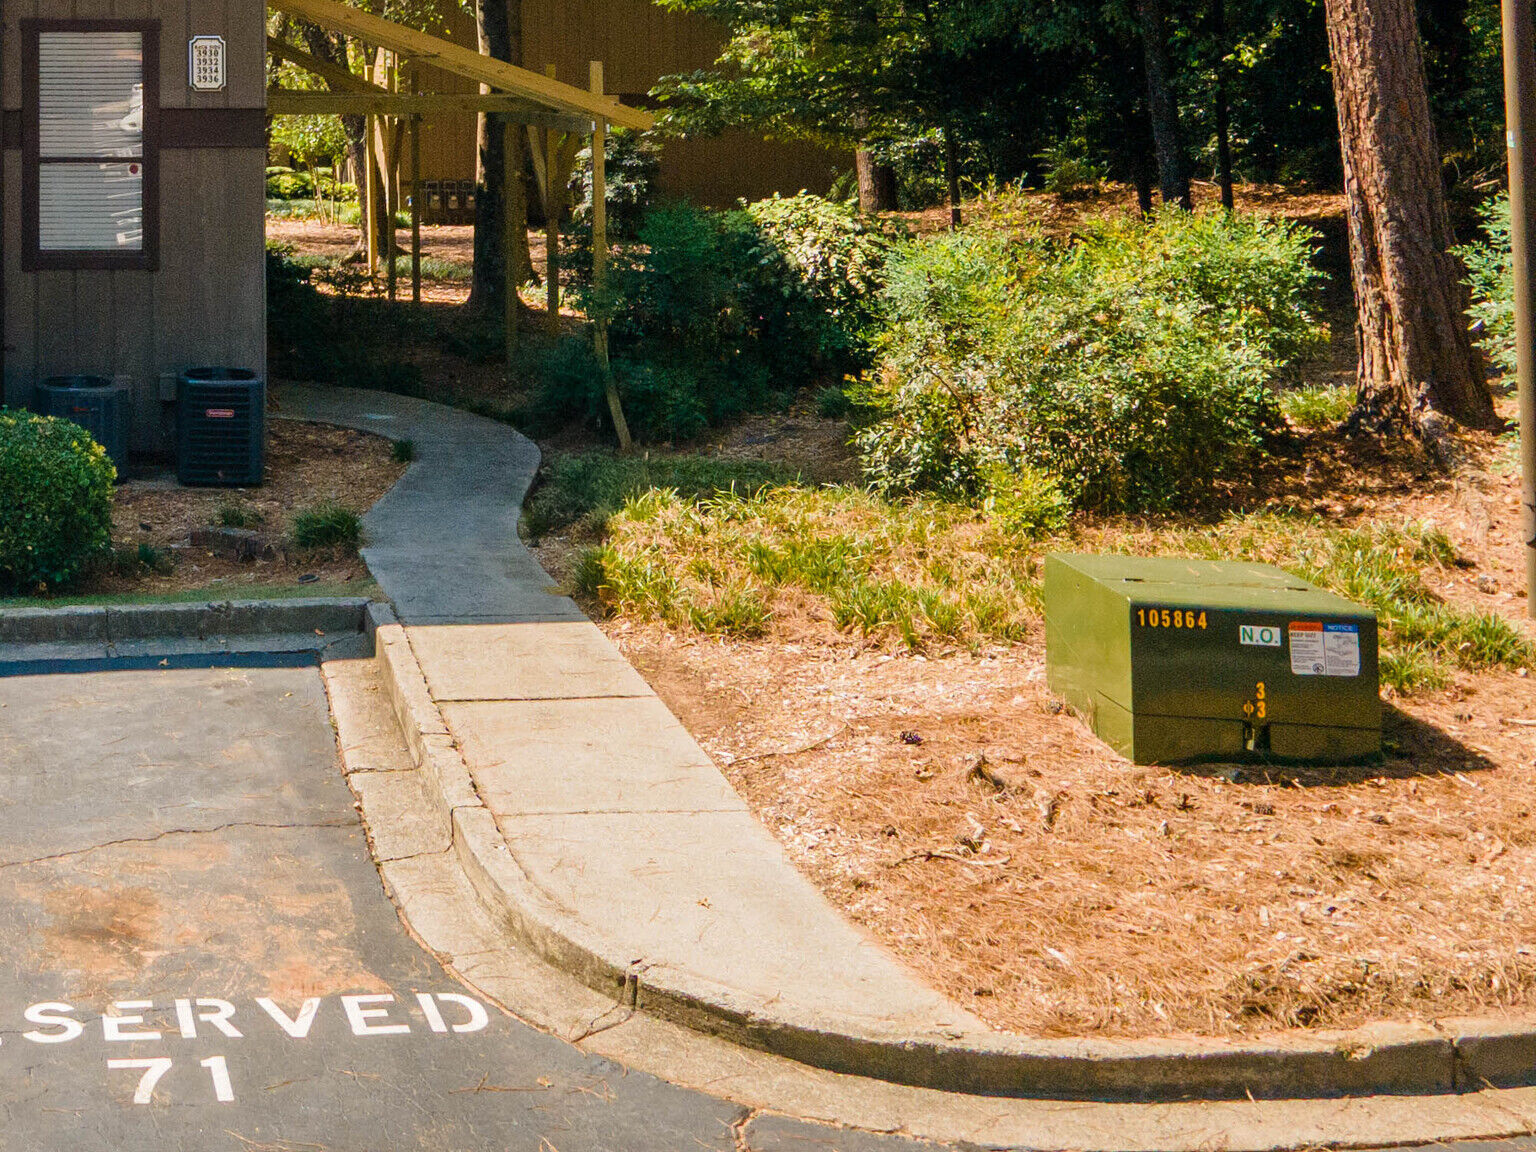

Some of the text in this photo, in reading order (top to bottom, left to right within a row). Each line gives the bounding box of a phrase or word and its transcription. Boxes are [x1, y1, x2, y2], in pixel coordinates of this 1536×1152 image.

[196, 66, 219, 74] 3934
[196, 75, 219, 83] 3936
[1137, 609, 1207, 630] 105864
[1241, 628, 1279, 644] N.O.
[1256, 682, 1265, 699] 3
[106, 1055, 235, 1105] 71
